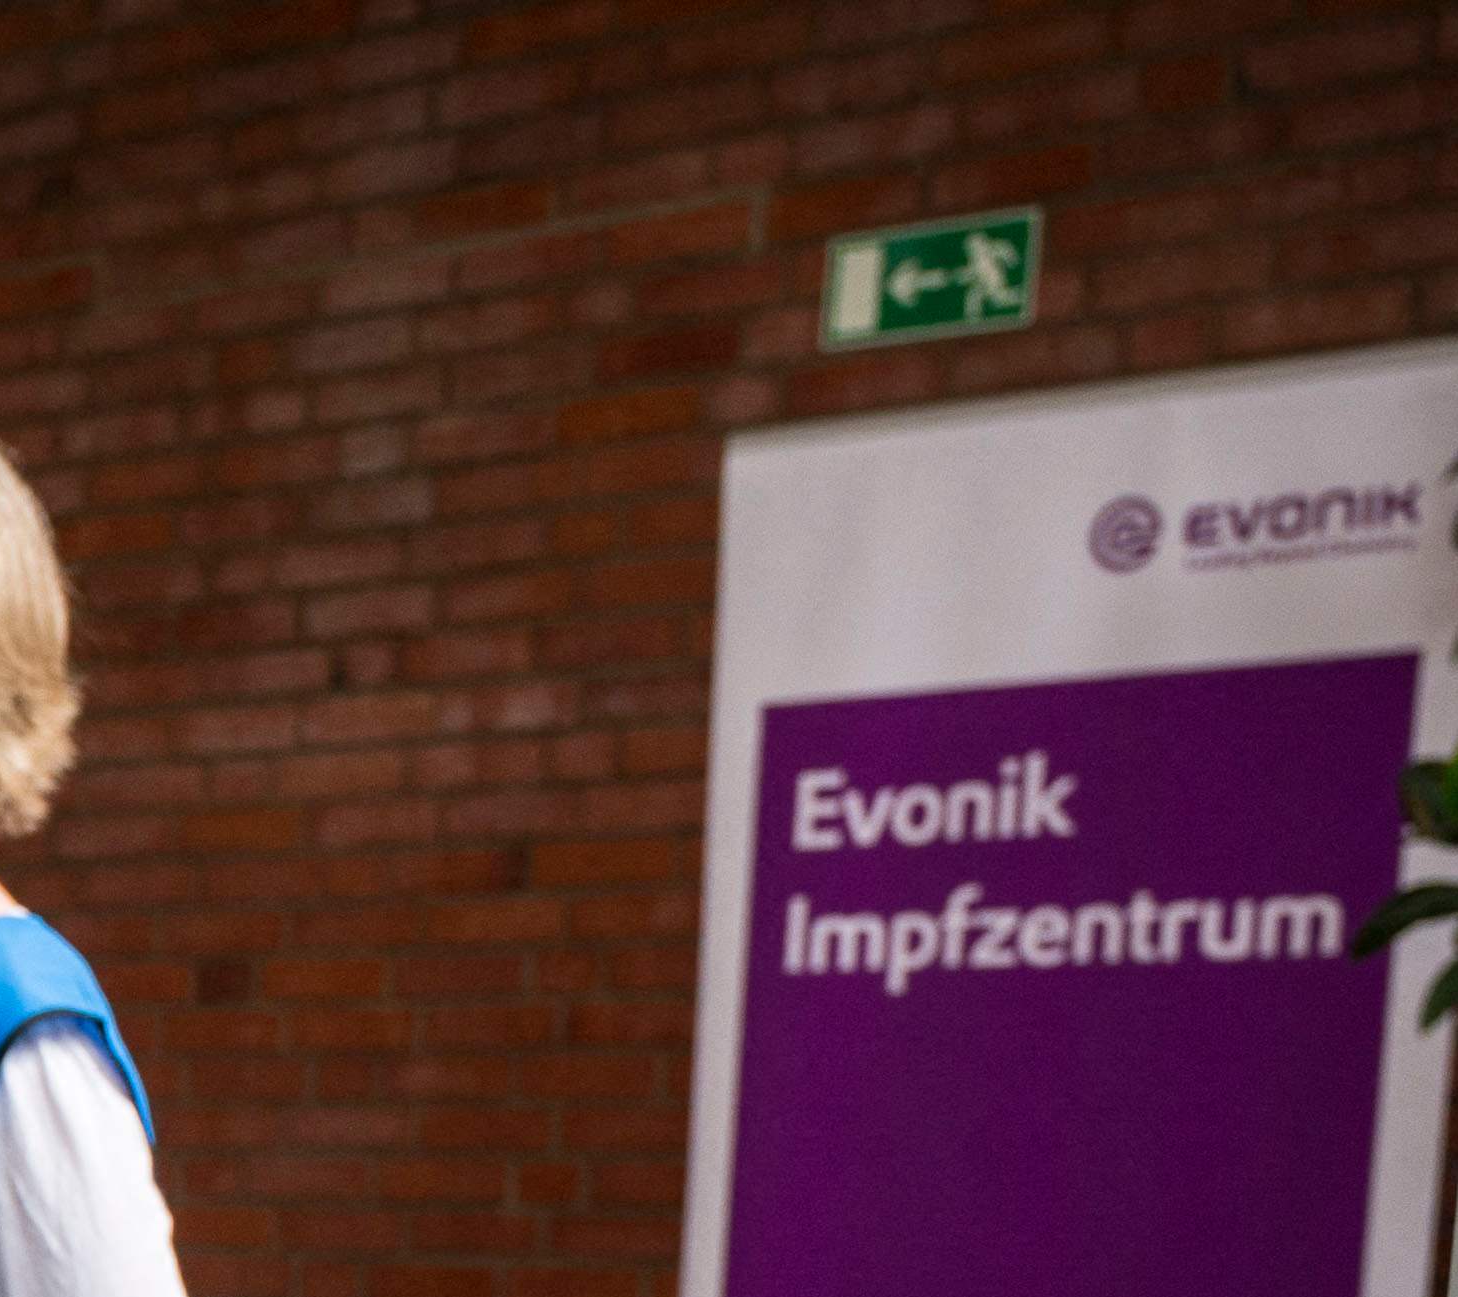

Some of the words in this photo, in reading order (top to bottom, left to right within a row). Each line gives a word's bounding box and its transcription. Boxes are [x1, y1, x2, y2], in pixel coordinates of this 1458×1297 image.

[1183, 481, 1422, 547] EVONIK
[791, 749, 1080, 853] Evonik
[782, 881, 1345, 996] Impfzentrum
